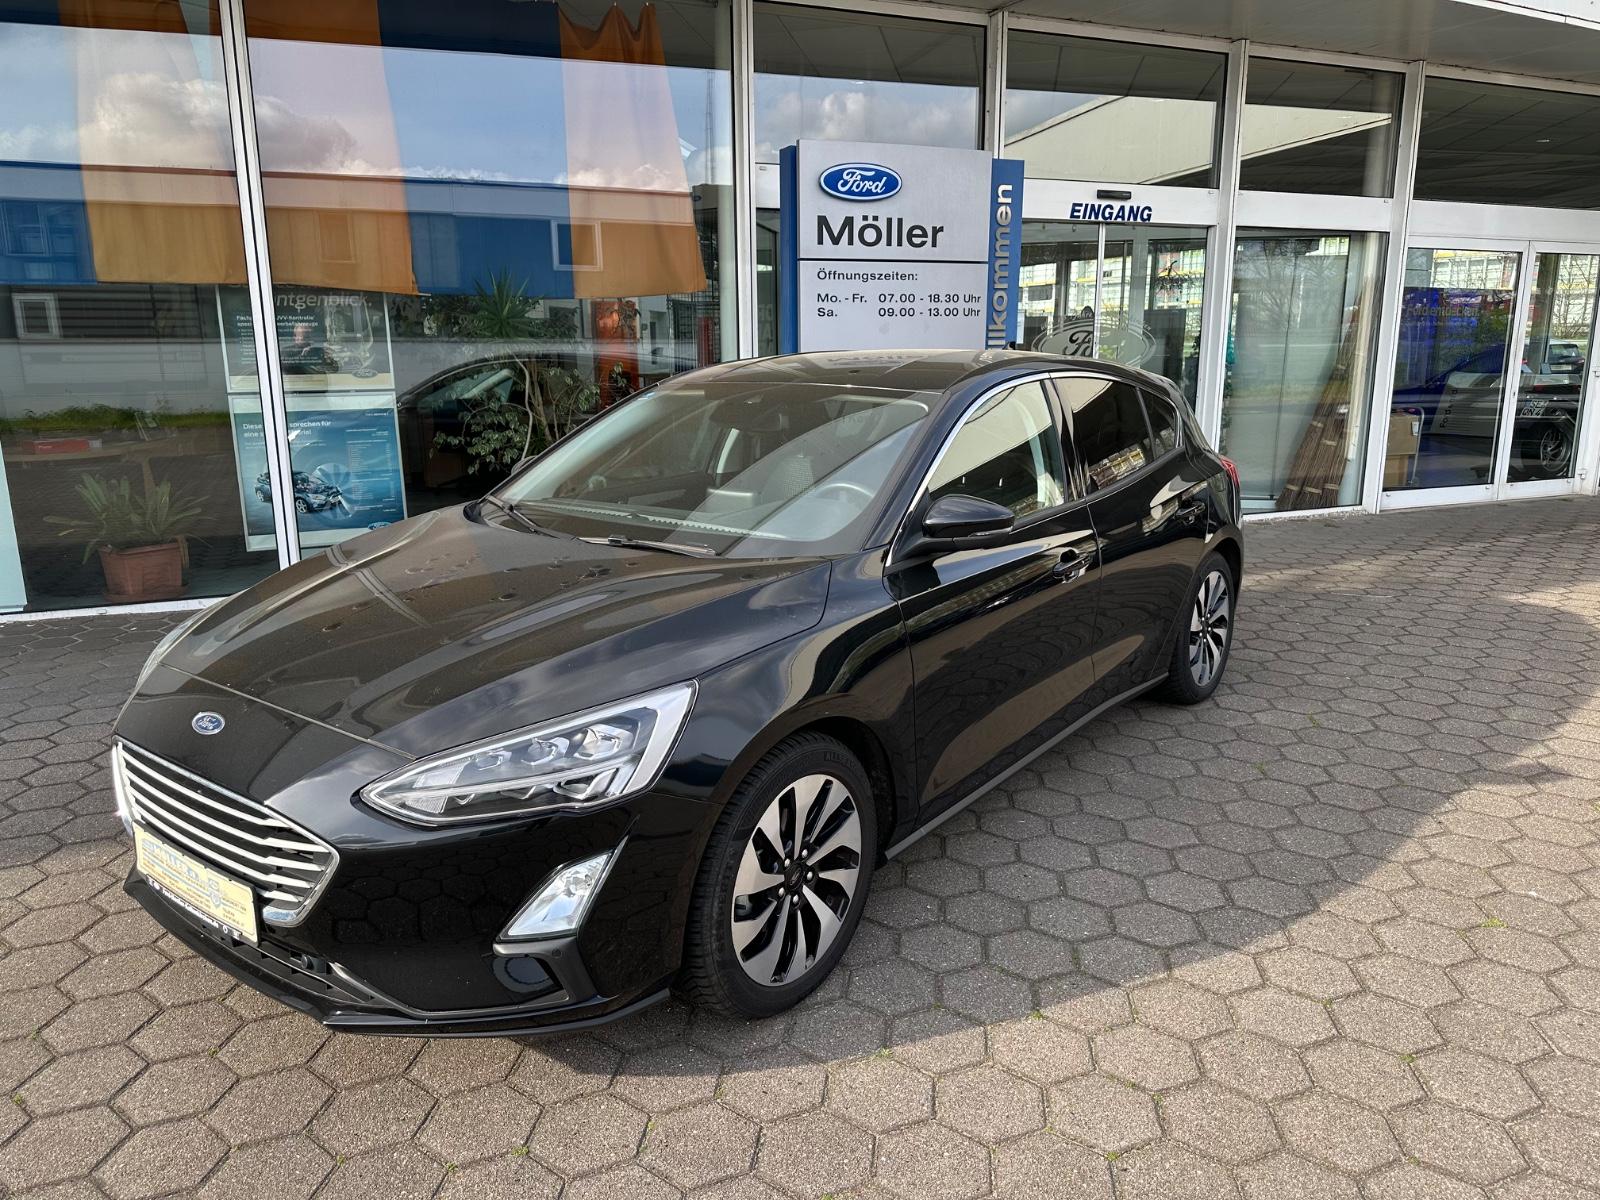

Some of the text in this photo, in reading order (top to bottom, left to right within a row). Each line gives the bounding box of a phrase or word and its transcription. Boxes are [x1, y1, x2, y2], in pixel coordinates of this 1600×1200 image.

[837, 169, 887, 195] Ford
[1069, 202, 1153, 222] EINGANG
[816, 214, 944, 249] Möller
[816, 267, 919, 284] Öffnungszeiten:
[987, 184, 1013, 350] llkommen
[274, 291, 373, 310] ntgenblick.
[816, 293, 842, 304] Mo.
[852, 293, 868, 304] Fr.
[878, 293, 916, 304] 07.00
[927, 293, 960, 304] 18.30
[963, 293, 982, 304] Uhr
[816, 307, 838, 318] Sa.
[878, 307, 916, 318] 09.00
[927, 307, 960, 318] 13.00
[963, 307, 982, 318] Uhr
